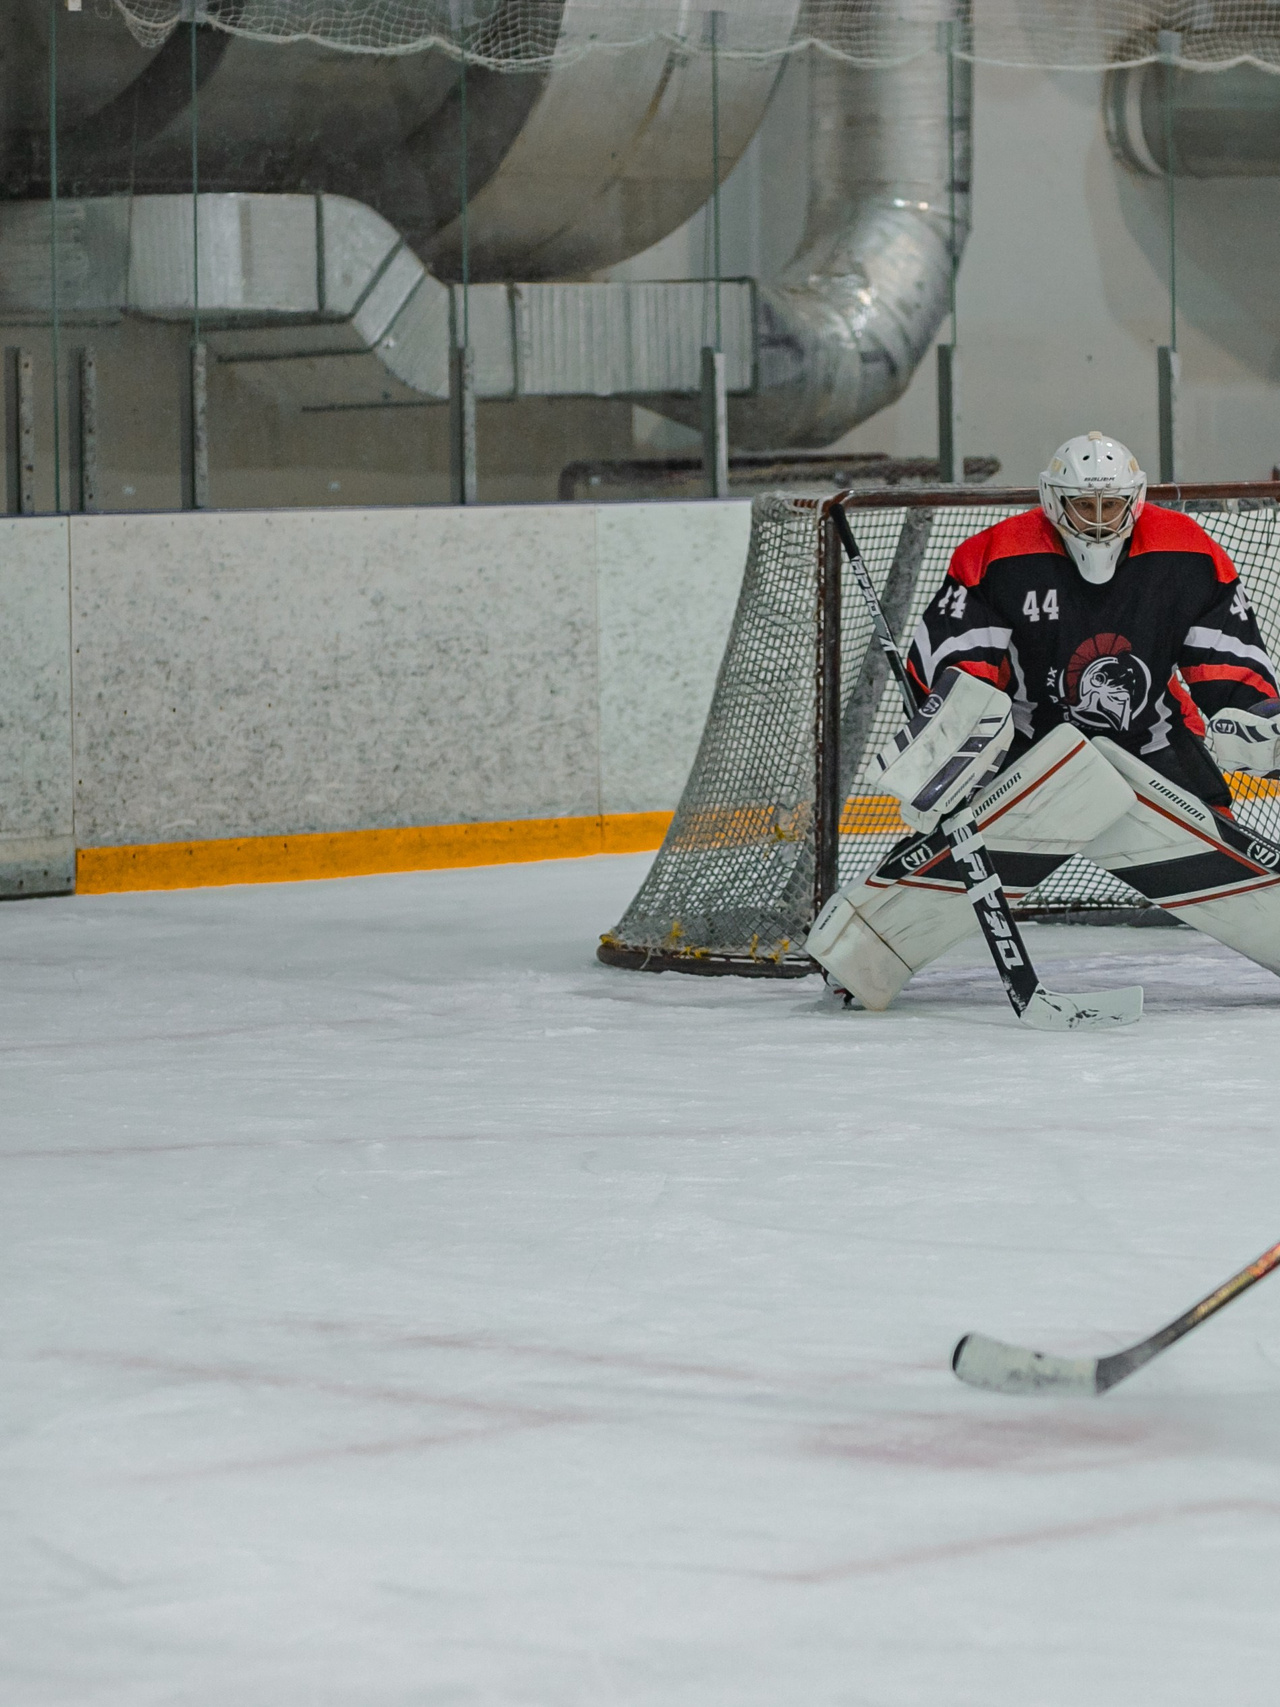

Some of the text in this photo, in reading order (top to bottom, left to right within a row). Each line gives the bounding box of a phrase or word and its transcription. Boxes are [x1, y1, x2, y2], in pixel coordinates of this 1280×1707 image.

[1022, 589, 1059, 622] 44
[972, 772, 1022, 819] WARRIOR
[1149, 779, 1207, 822] WARRIOR
